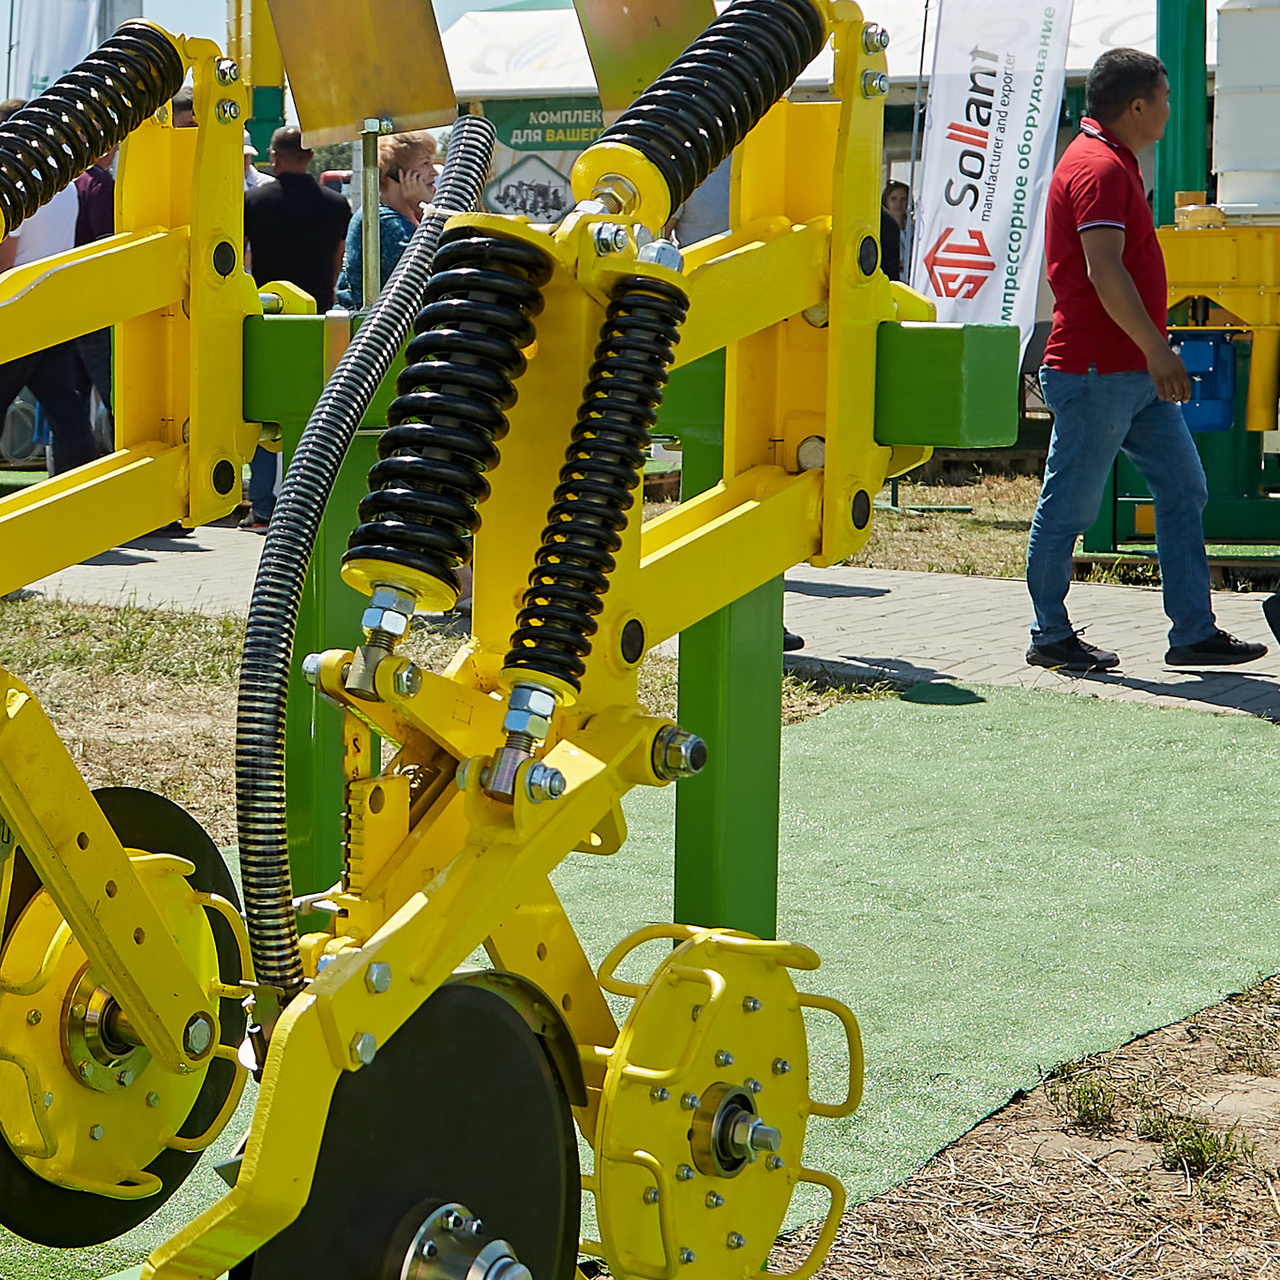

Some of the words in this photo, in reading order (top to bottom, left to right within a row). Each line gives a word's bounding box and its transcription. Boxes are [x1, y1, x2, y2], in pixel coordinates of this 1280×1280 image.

[999, 52, 1016, 107] exporter
[510, 129, 542, 144] ДЛЯ
[528, 109, 603, 124] КОМПЛЕК
[944, 44, 999, 212] Sollant
[995, 110, 1009, 133] and
[981, 136, 1005, 222] manufacturer
[1001, 175, 1028, 322] мпрессорное
[1017, 6, 1056, 170] оборудование
